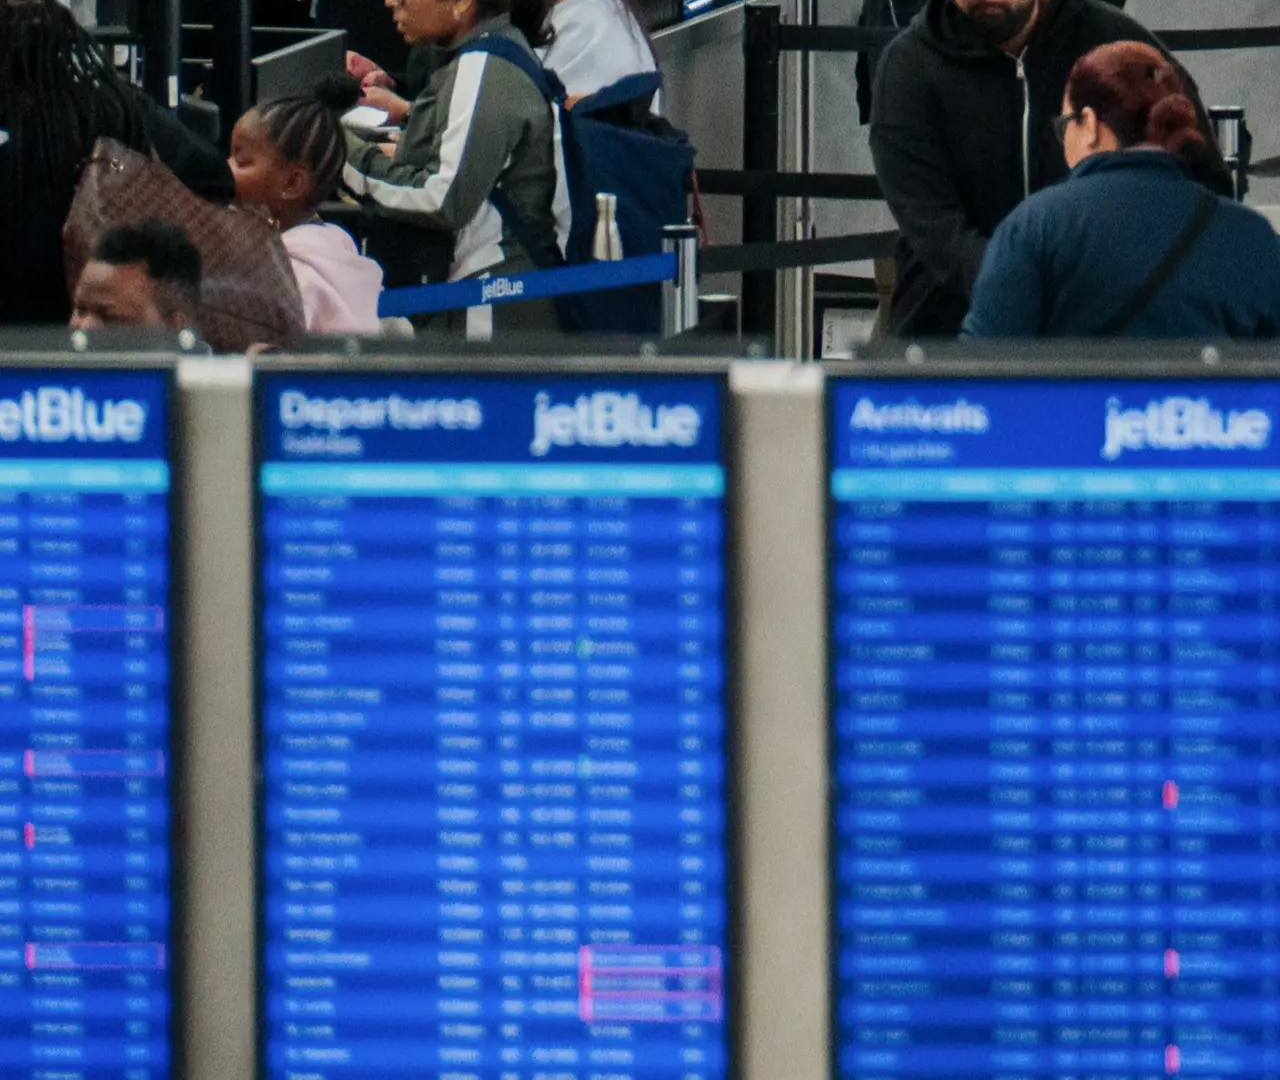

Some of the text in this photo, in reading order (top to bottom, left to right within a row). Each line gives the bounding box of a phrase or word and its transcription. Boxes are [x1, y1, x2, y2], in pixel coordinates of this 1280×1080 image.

[482, 277, 524, 303] jetBlue
[0, 385, 146, 442] etBlue
[279, 390, 700, 456] Departures jetBlue
[849, 395, 1271, 460] Arrivals jetBlue
